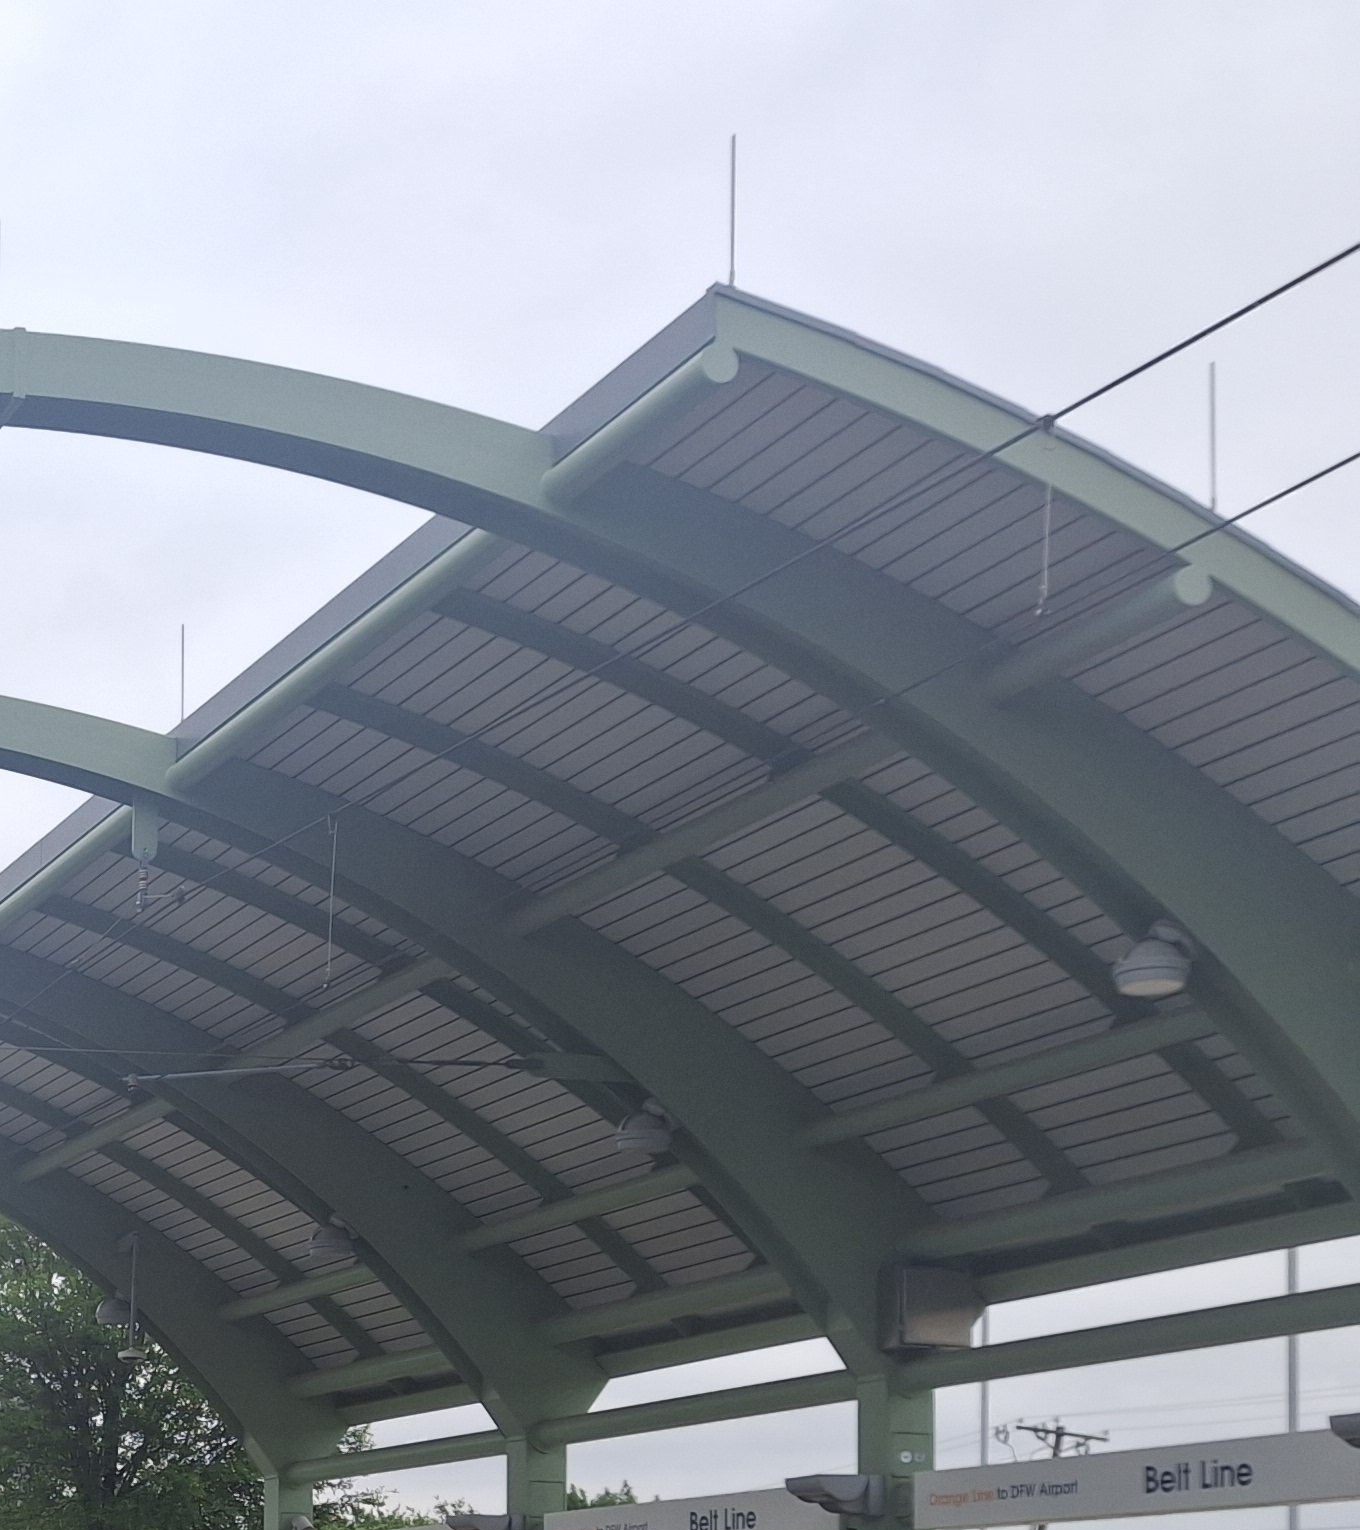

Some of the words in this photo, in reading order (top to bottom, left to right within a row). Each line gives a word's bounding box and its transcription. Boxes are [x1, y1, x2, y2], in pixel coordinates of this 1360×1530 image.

[1145, 1462, 1190, 1494] Belt
[1201, 1459, 1254, 1490] Line
[996, 1487, 1009, 1500] to
[1011, 1483, 1036, 1499] DFW
[1039, 1478, 1079, 1497] Airport
[724, 1507, 757, 1530] Line
